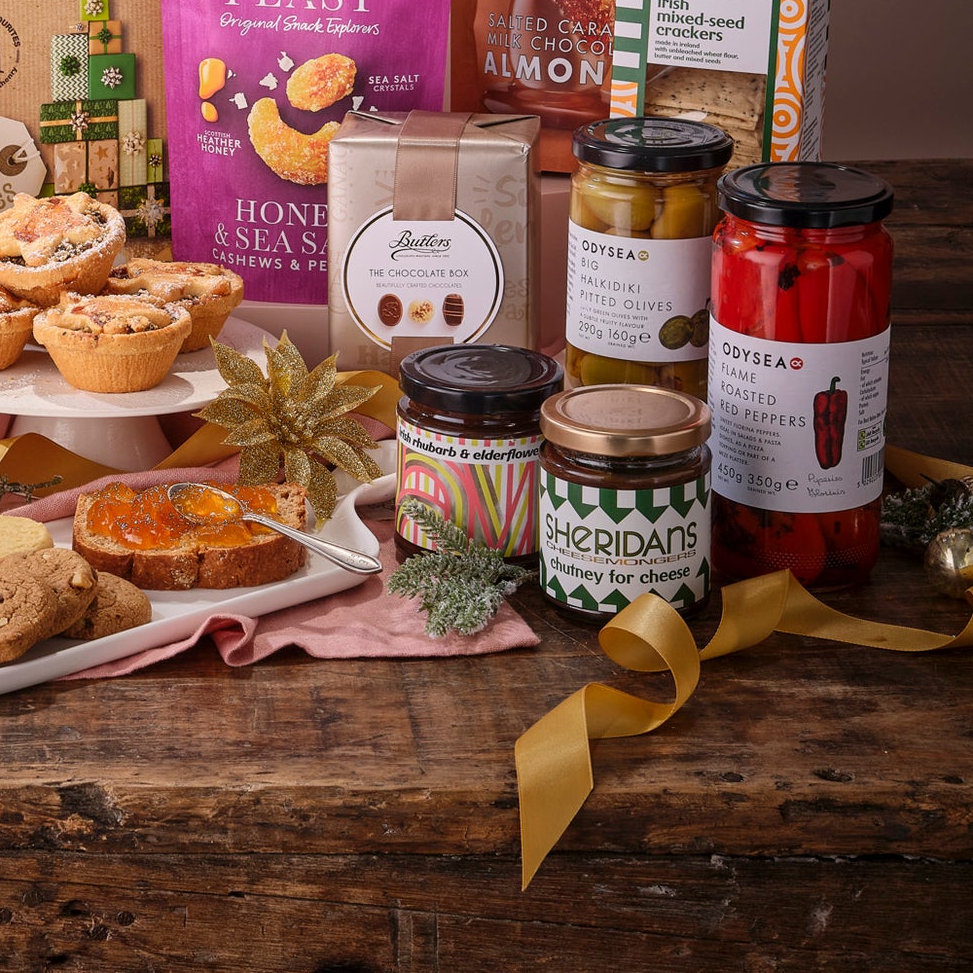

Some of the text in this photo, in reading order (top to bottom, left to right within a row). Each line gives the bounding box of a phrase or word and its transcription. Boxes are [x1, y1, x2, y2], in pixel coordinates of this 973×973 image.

[219, 12, 380, 38] Original Snack Explorers
[488, 13, 613, 37] SALTED CARA
[657, 12, 745, 30] mixed-seed
[487, 32, 613, 57] MILK CHOCOL
[656, 25, 723, 42] crackers
[368, 74, 420, 84] SEA SALT
[483, 51, 604, 86] ALMON
[373, 83, 415, 92] CRYSTALS
[196, 133, 242, 149] HEATHER
[204, 129, 231, 138] SCOTTISH
[201, 144, 236, 157] HONEY
[235, 198, 328, 227] HONE
[214, 223, 230, 247] &
[235, 226, 294, 254] SEA
[388, 230, 452, 254] Butlers
[581, 240, 636, 261] ODYSEA
[212, 247, 327, 271] CASHEWS & PE
[581, 257, 599, 271] BIG
[369, 269, 469, 277] THE CHOCOLATE BOX
[580, 274, 641, 294] HALKIDIKI
[580, 289, 673, 312] PITTED OLIVES
[722, 342, 787, 370] ODYSEA
[721, 362, 757, 384] FLAME
[720, 380, 777, 406] ROASTED
[720, 399, 807, 428] RED PEPPERS
[412, 438, 457, 458] rhubarb
[460, 448, 470, 459] &
[474, 447, 539, 462] elderflowe
[546, 540, 697, 566] CHEESEMONGERS
[550, 557, 691, 585] chutney for cheese
